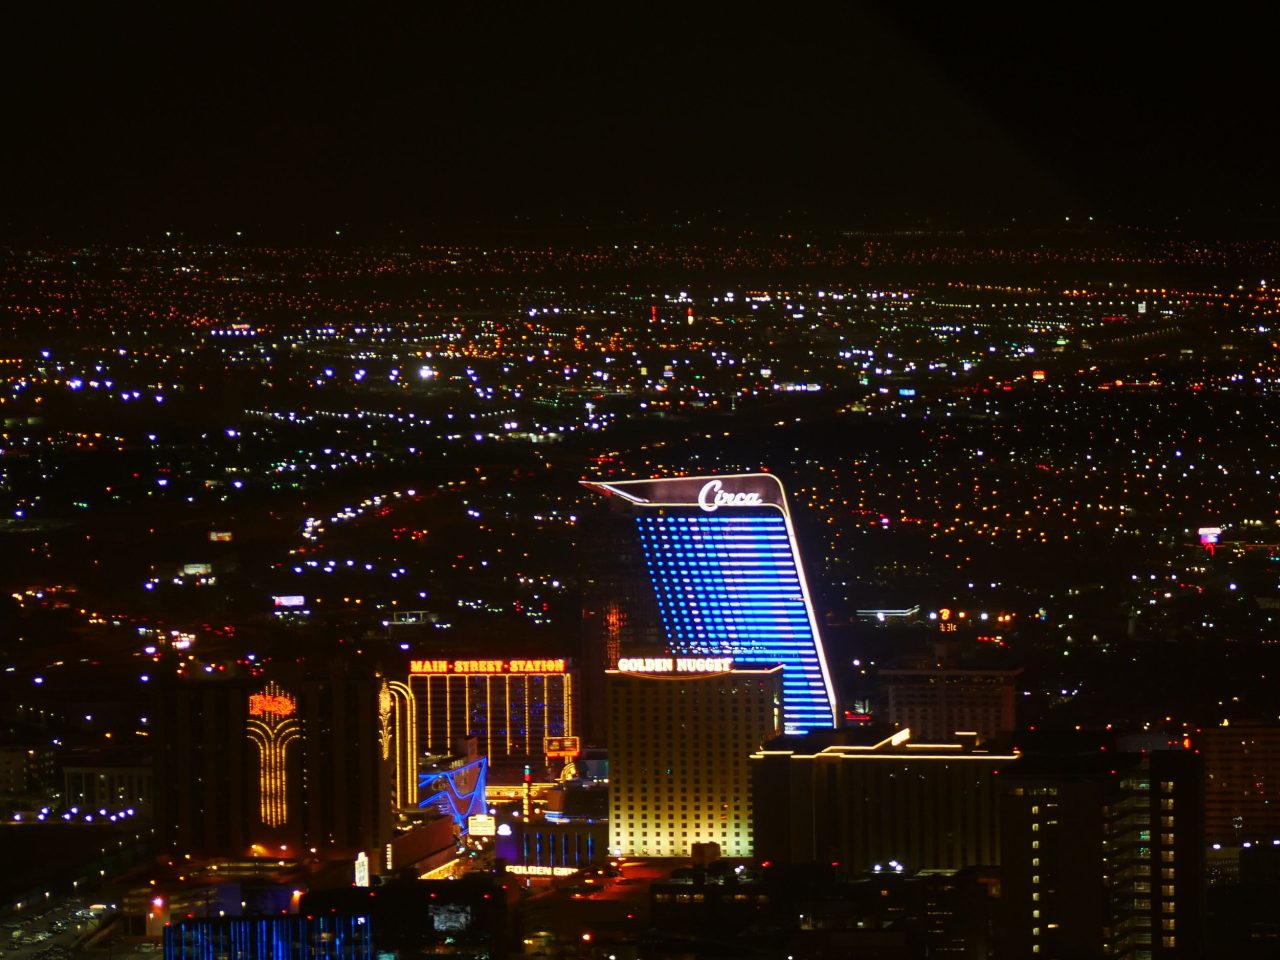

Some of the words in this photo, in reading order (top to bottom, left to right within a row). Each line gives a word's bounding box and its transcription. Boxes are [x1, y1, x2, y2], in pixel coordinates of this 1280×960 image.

[698, 480, 763, 512] Circa
[410, 660, 447, 672] MAIN
[454, 660, 503, 672] STREET
[509, 659, 566, 672] STATION
[618, 658, 673, 672] GOLDEN
[676, 657, 734, 672] NUGGET
[505, 865, 552, 875] GOLDEN
